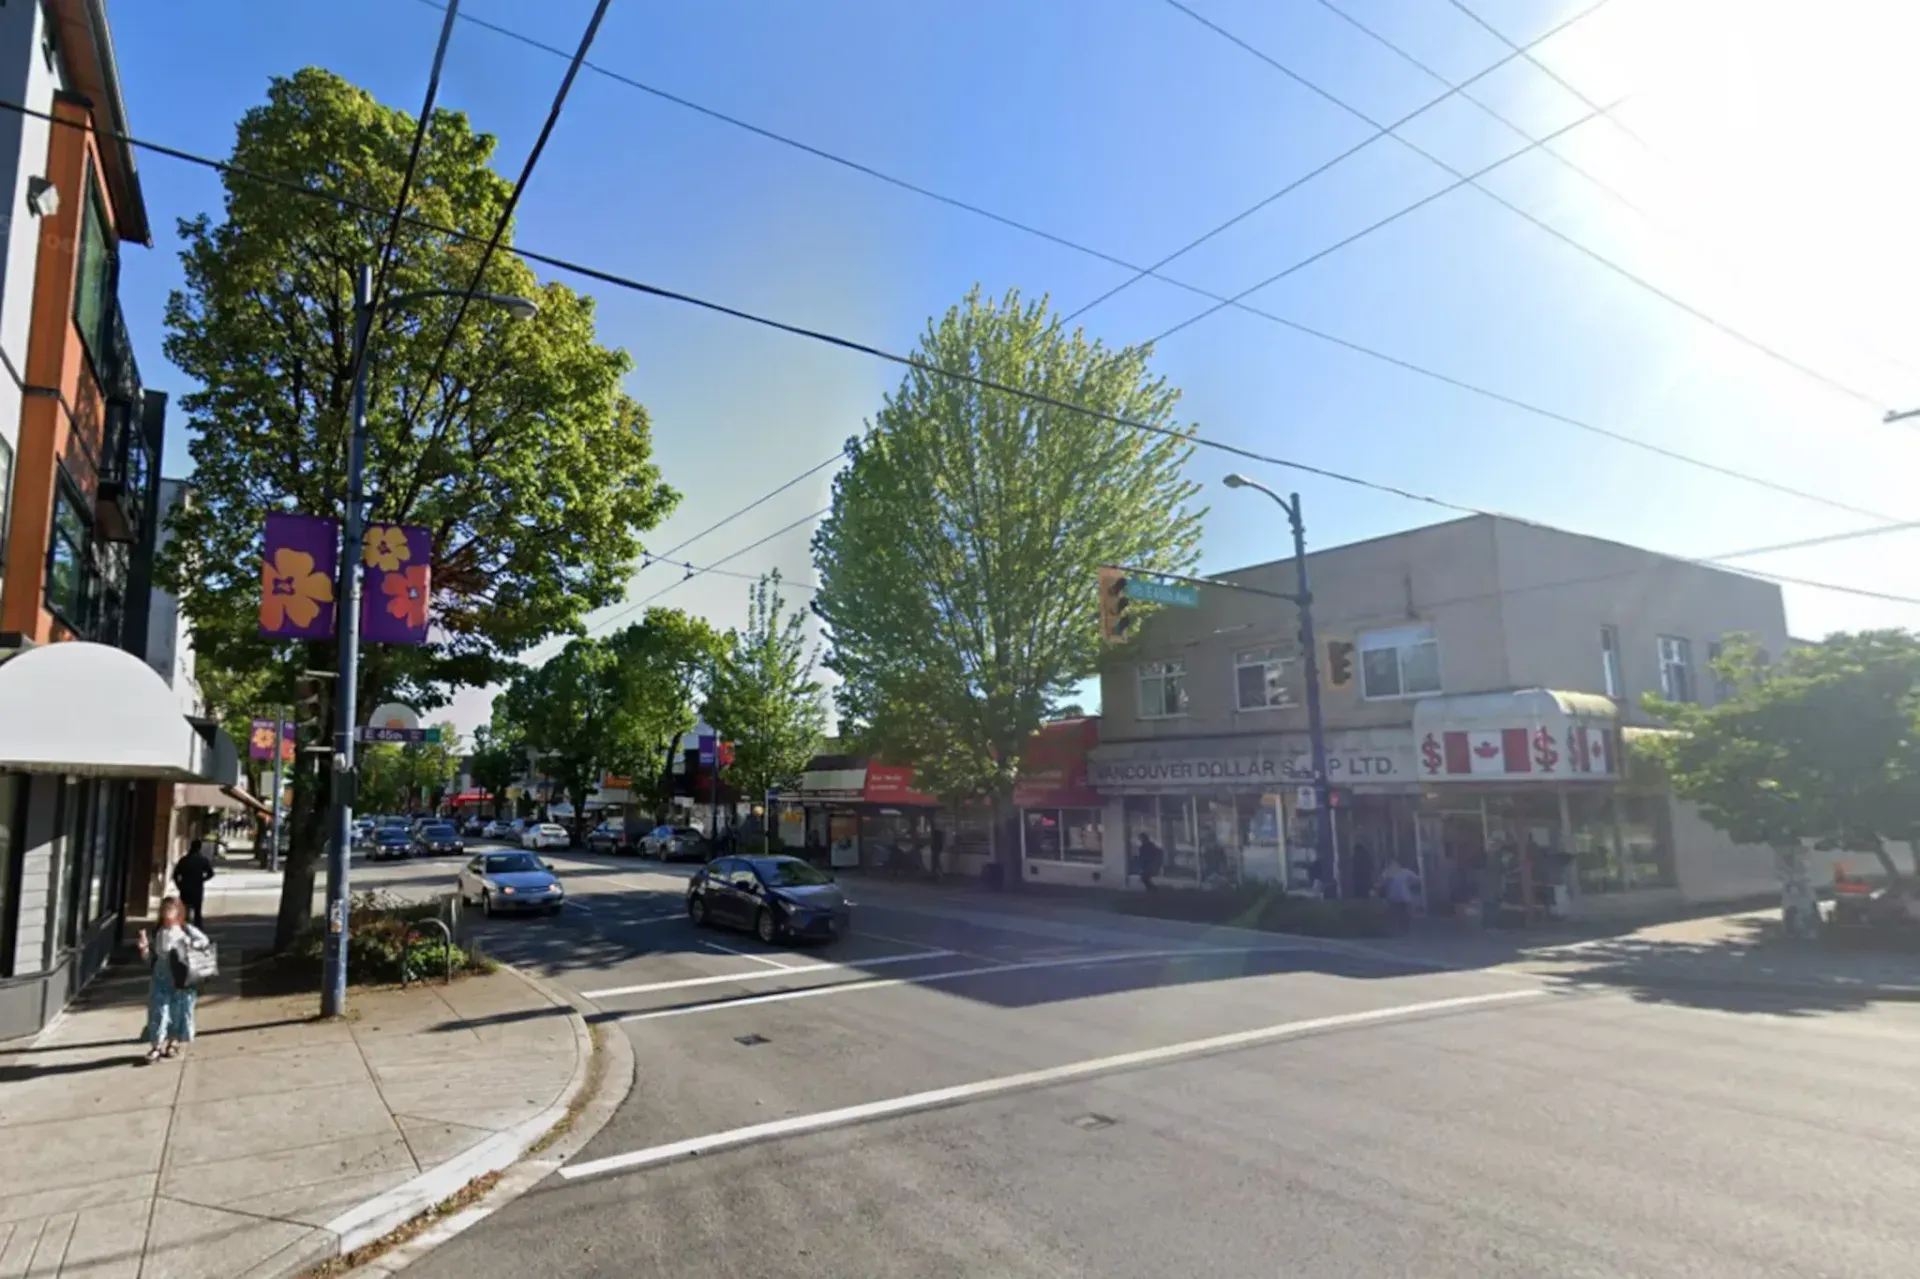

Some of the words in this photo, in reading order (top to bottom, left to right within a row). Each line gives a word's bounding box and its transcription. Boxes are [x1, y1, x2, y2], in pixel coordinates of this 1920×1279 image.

[1097, 763, 1192, 779] VANCOUVER
[1197, 759, 1275, 778] DOLLAR
[1281, 757, 1342, 778] SP
[1349, 756, 1398, 775] LTD.
[1421, 732, 1442, 774] $
[1534, 725, 1559, 772] $
